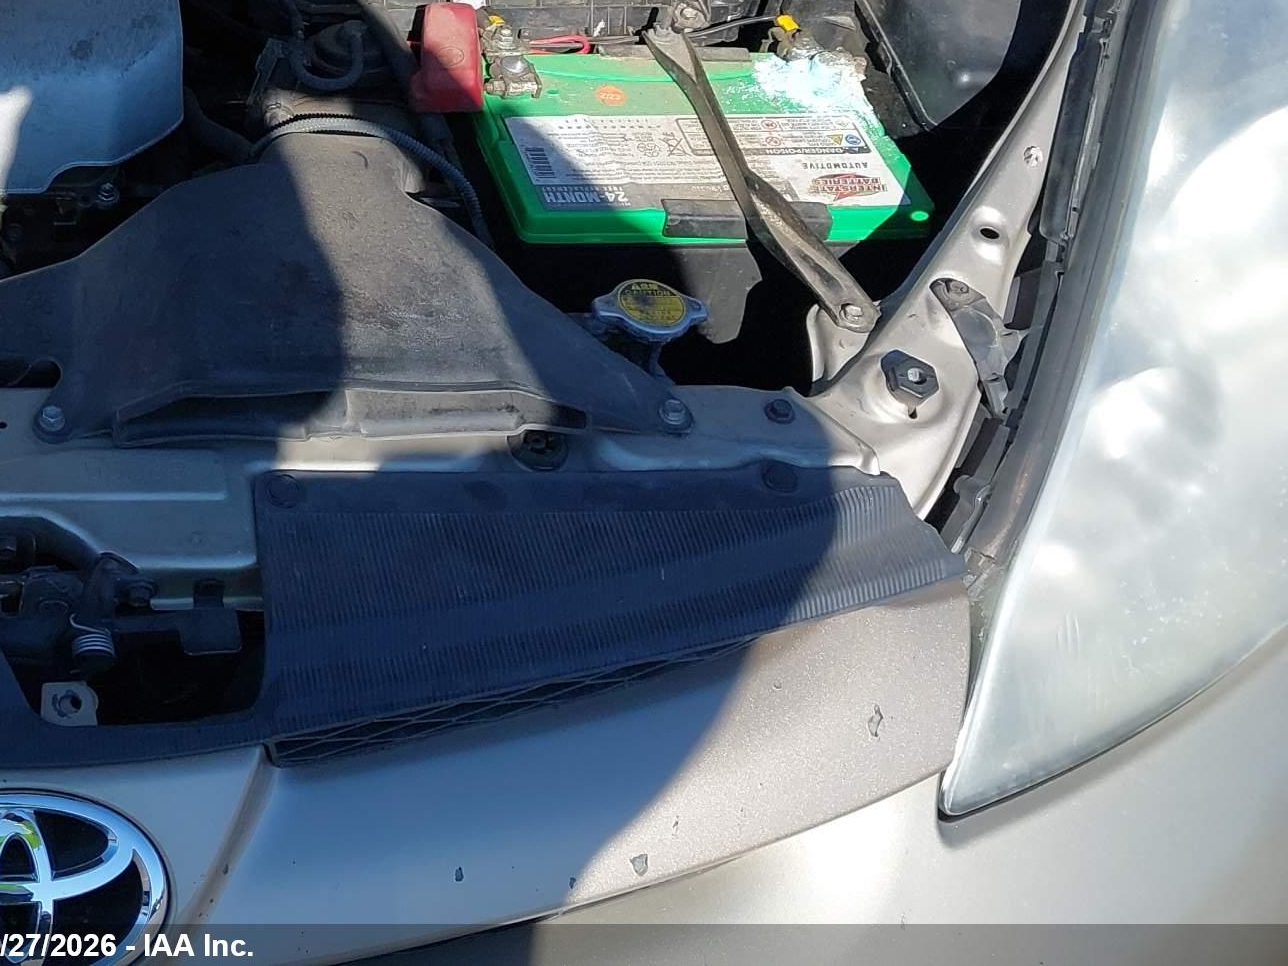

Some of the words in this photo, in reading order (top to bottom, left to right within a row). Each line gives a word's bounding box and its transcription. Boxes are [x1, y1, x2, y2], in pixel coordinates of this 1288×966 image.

[814, 177, 880, 185] BATTERIES
[811, 184, 888, 193] INTERSTATE
[543, 191, 629, 203] 24-MONTH
